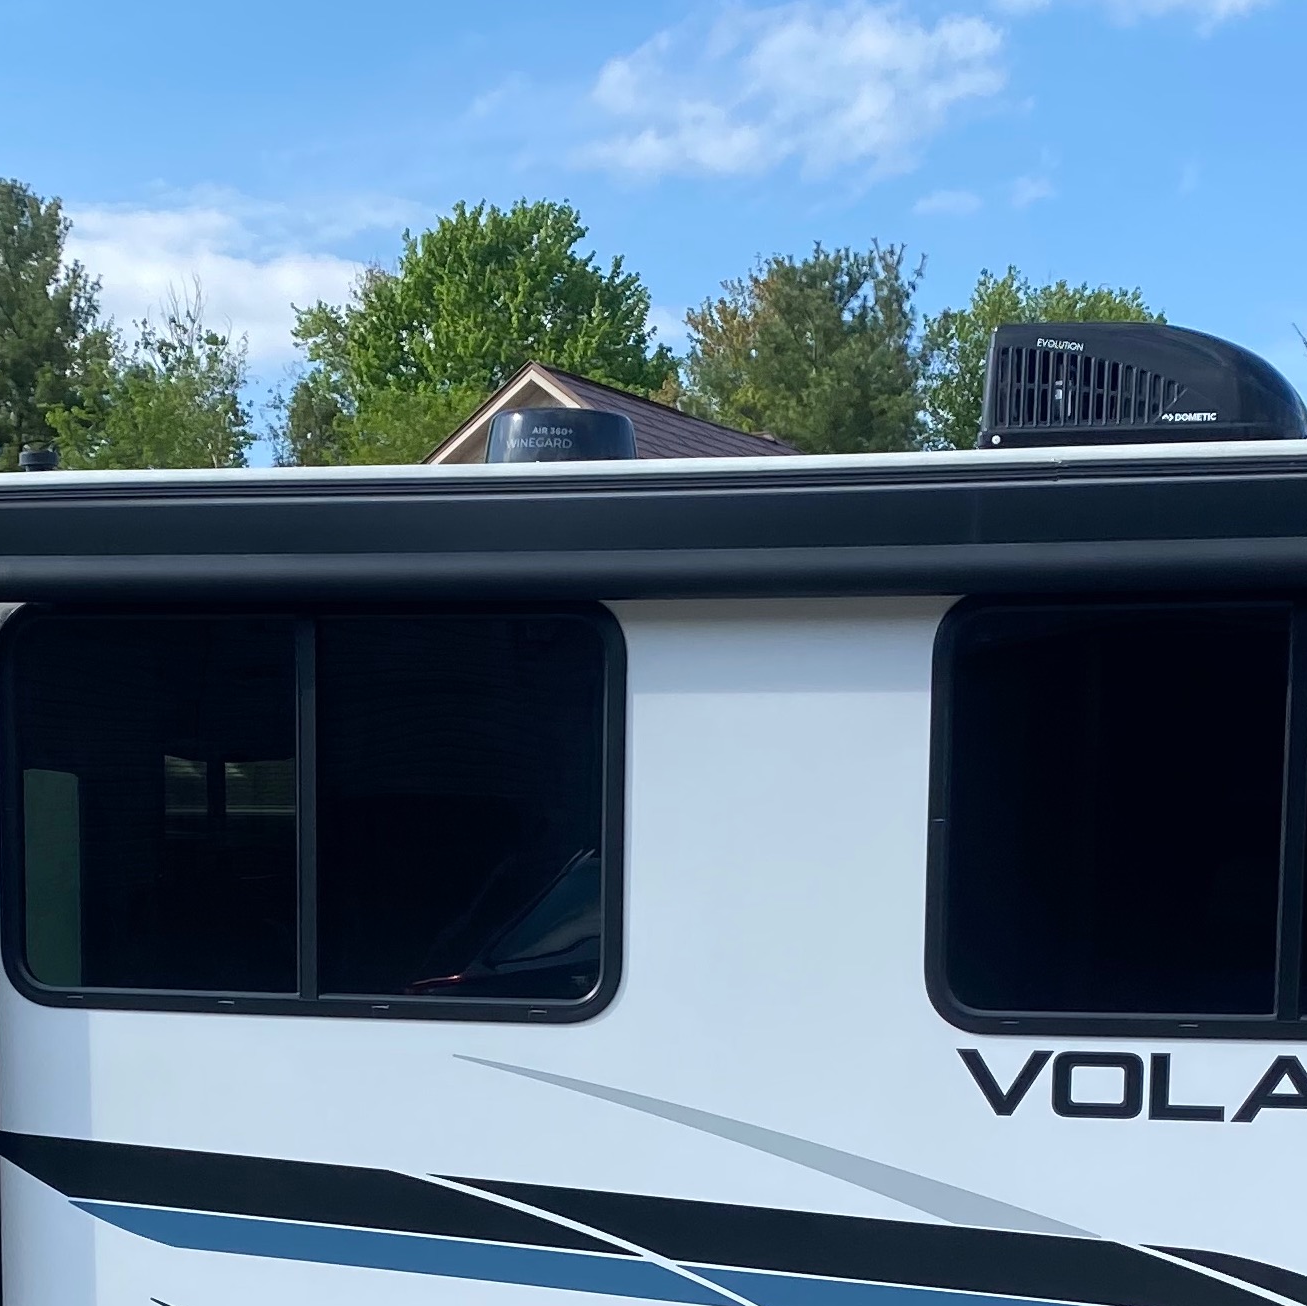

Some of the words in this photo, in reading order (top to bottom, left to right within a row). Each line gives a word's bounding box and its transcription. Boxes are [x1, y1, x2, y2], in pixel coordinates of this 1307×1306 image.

[1036, 338, 1084, 352] EVOLUTION
[1174, 412, 1217, 422] DOMETIC
[532, 426, 548, 435] AIR
[550, 426, 573, 436] 360+
[506, 437, 573, 449] WINEGARD
